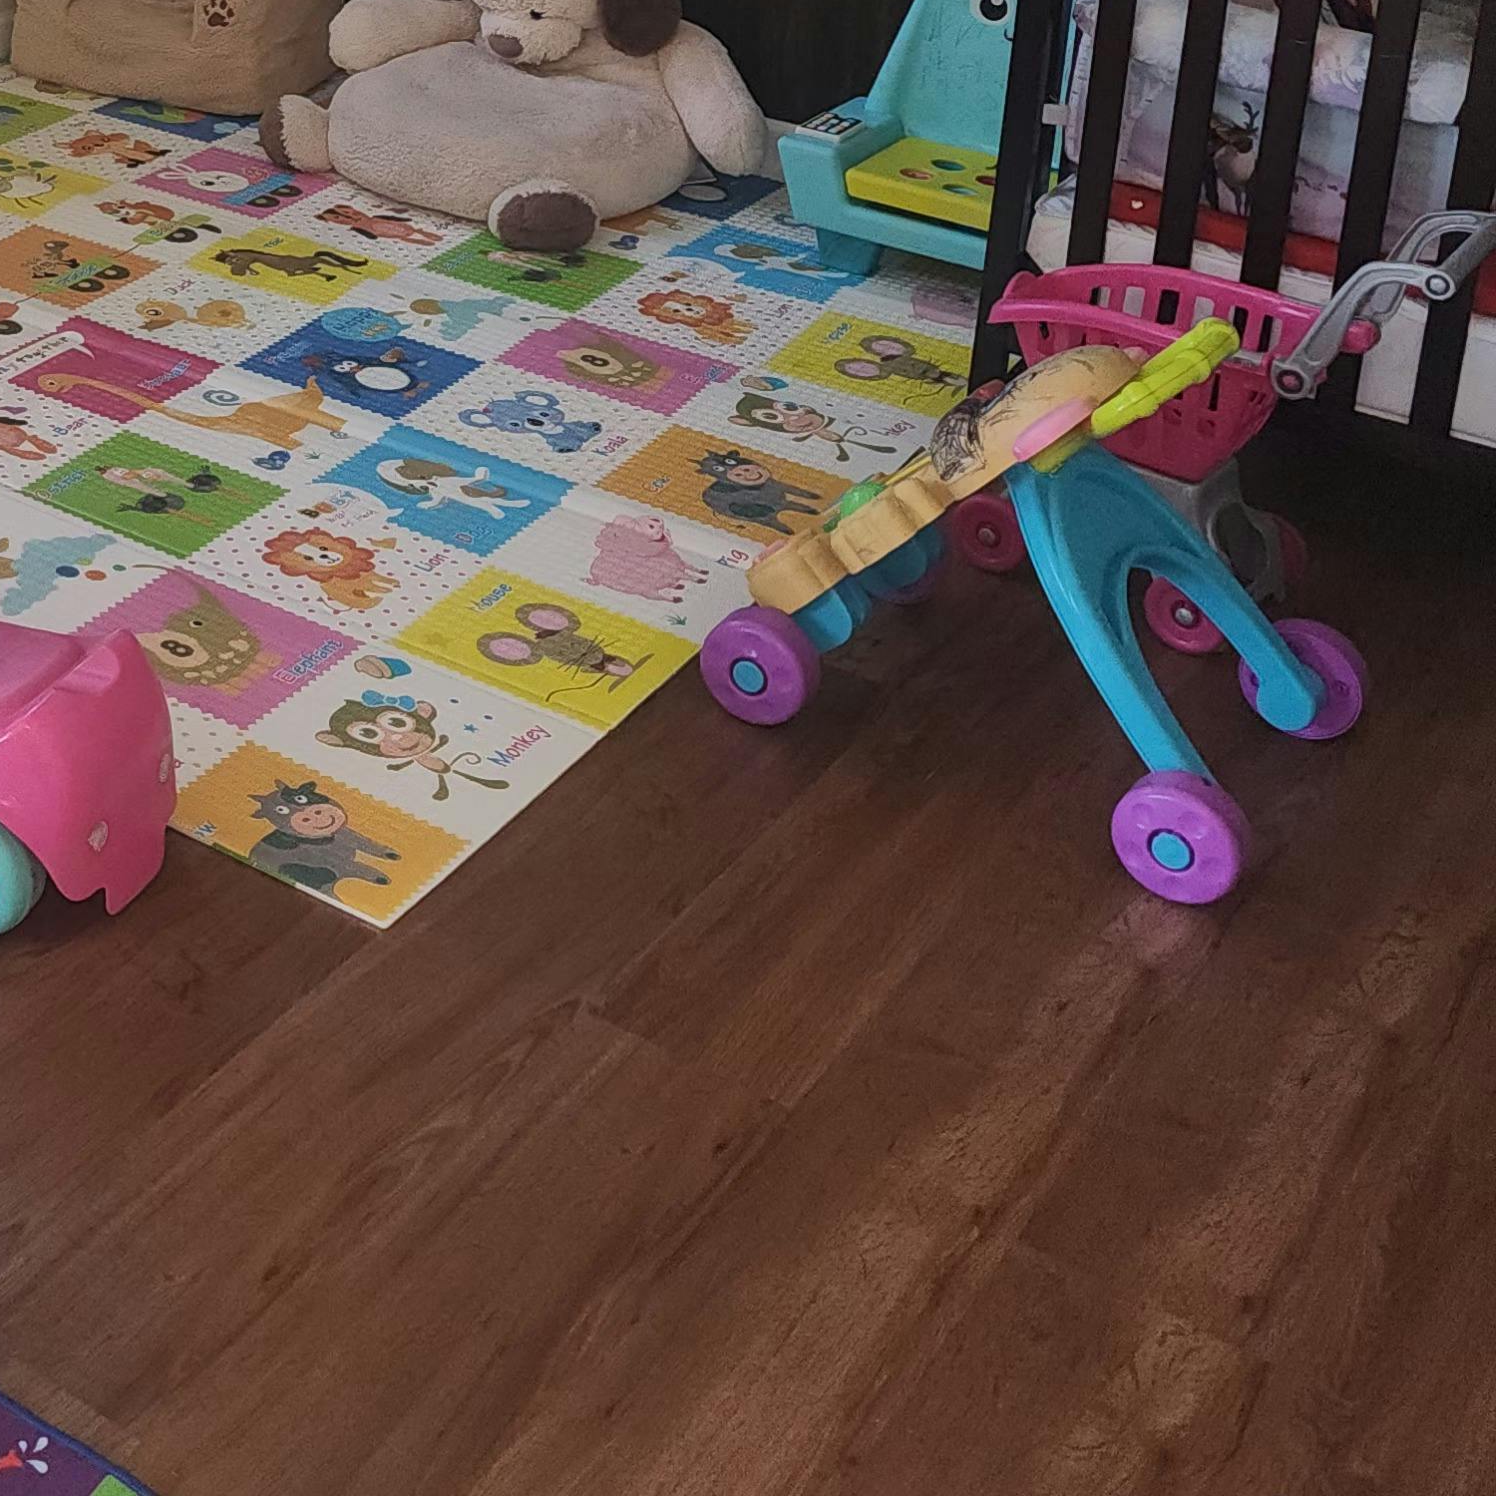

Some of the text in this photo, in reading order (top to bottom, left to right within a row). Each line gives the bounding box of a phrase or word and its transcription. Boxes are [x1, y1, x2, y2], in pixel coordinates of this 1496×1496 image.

[413, 551, 452, 573] Lion
[715, 547, 750, 569] Pig
[271, 636, 344, 686] Elephant
[488, 721, 553, 768] Monkey
